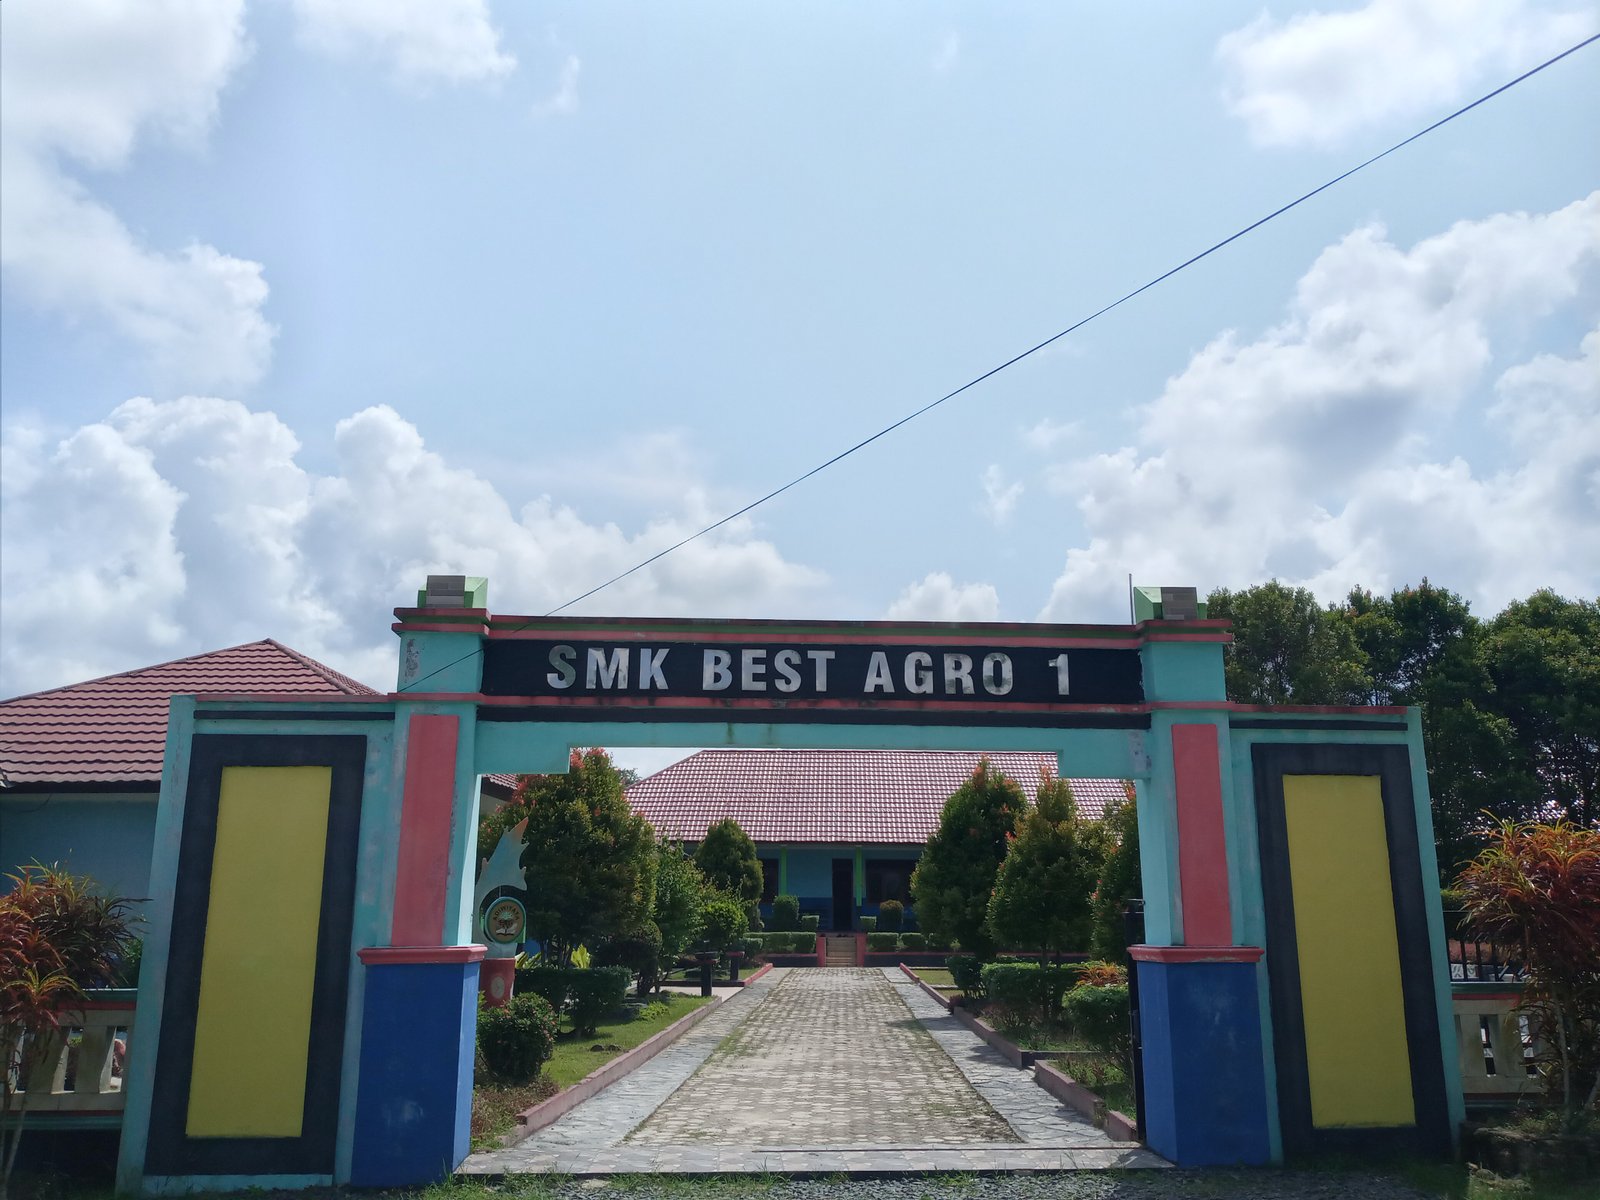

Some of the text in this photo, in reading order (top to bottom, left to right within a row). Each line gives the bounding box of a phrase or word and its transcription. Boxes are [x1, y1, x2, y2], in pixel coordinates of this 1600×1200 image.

[546, 644, 1070, 695] SMK BEST AGRO 1
